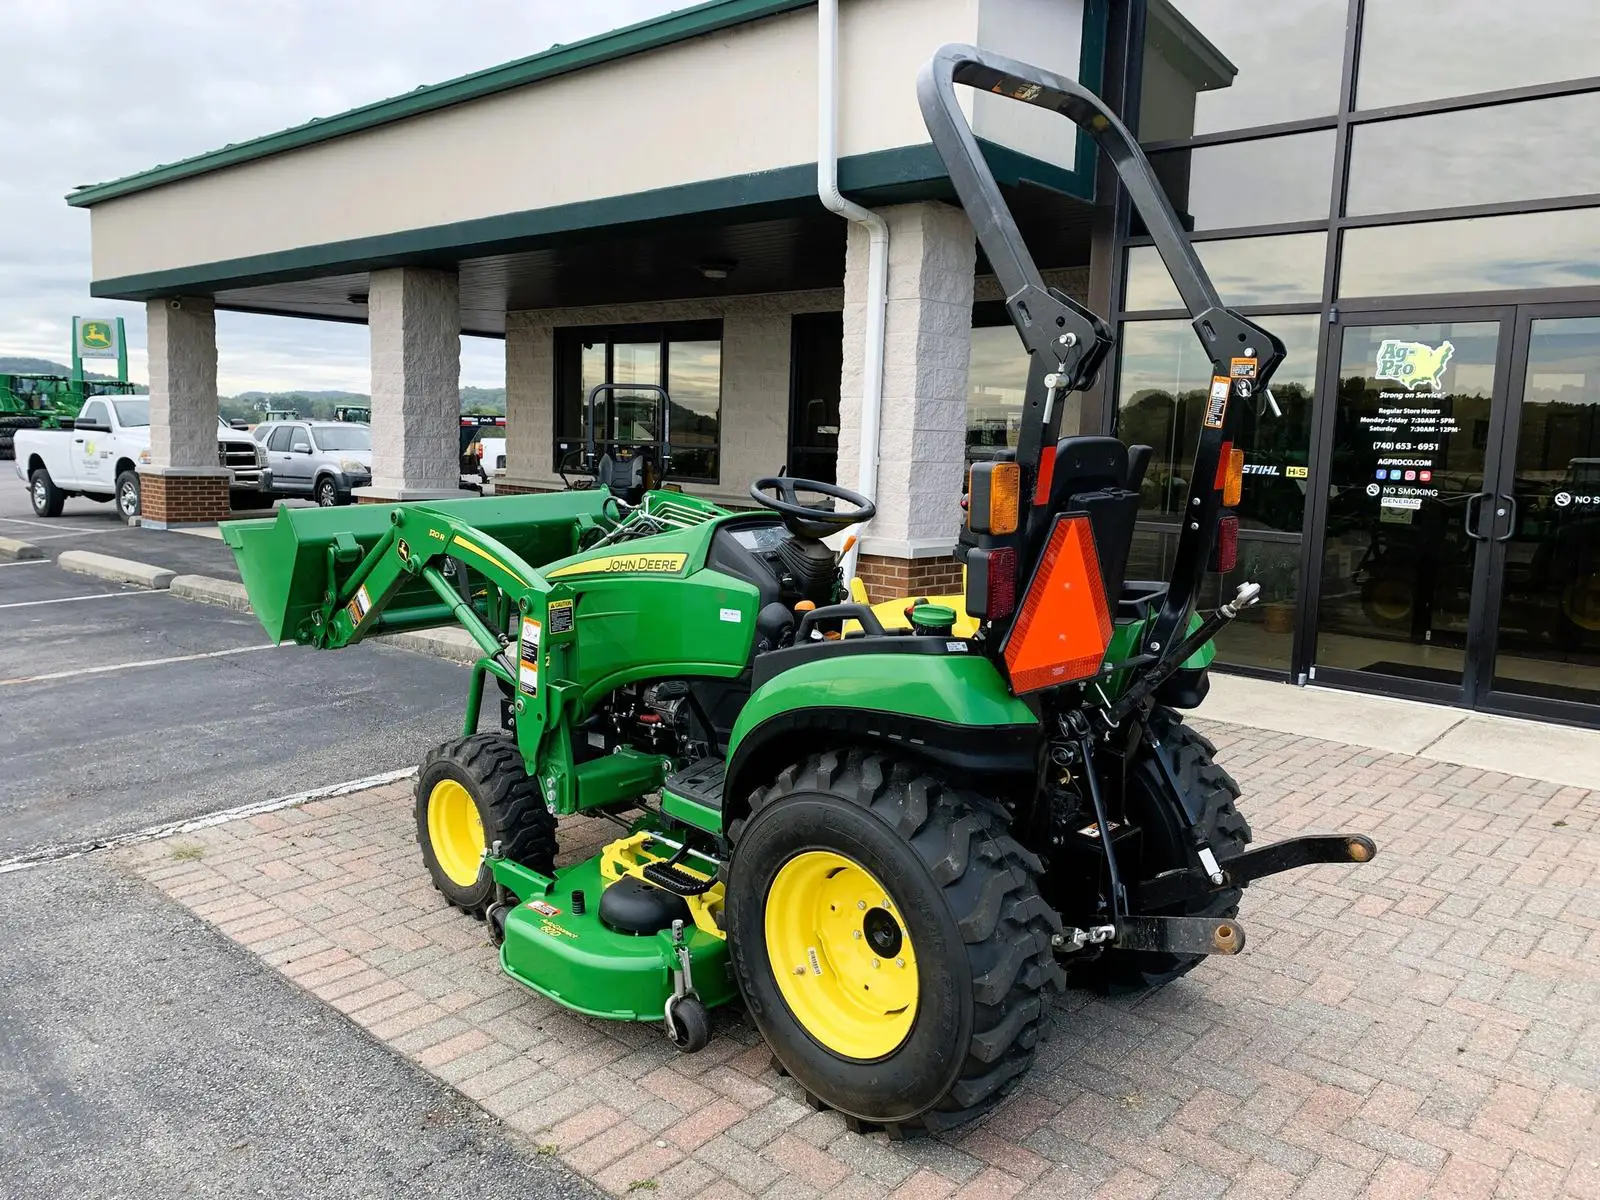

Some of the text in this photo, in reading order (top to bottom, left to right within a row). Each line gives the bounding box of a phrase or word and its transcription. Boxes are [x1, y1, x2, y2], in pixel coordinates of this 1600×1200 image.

[1381, 343, 1415, 363] Ag-
[1379, 359, 1414, 376] Pro
[1380, 391, 1404, 400] Strong
[1378, 407, 1403, 415] Regular
[1421, 407, 1441, 415] Hours
[1369, 425, 1398, 433] Saturday
[1372, 441, 1395, 451] (740)
[1395, 442, 1412, 450] 653
[1417, 443, 1439, 451] 6951
[1377, 458, 1432, 467] AGPROCO.COM
[1241, 464, 1280, 476] STIHL
[1382, 486, 1439, 497] NO SMOKING
[1575, 495, 1591, 504] NO
[605, 558, 678, 571] JOHN DEERE
